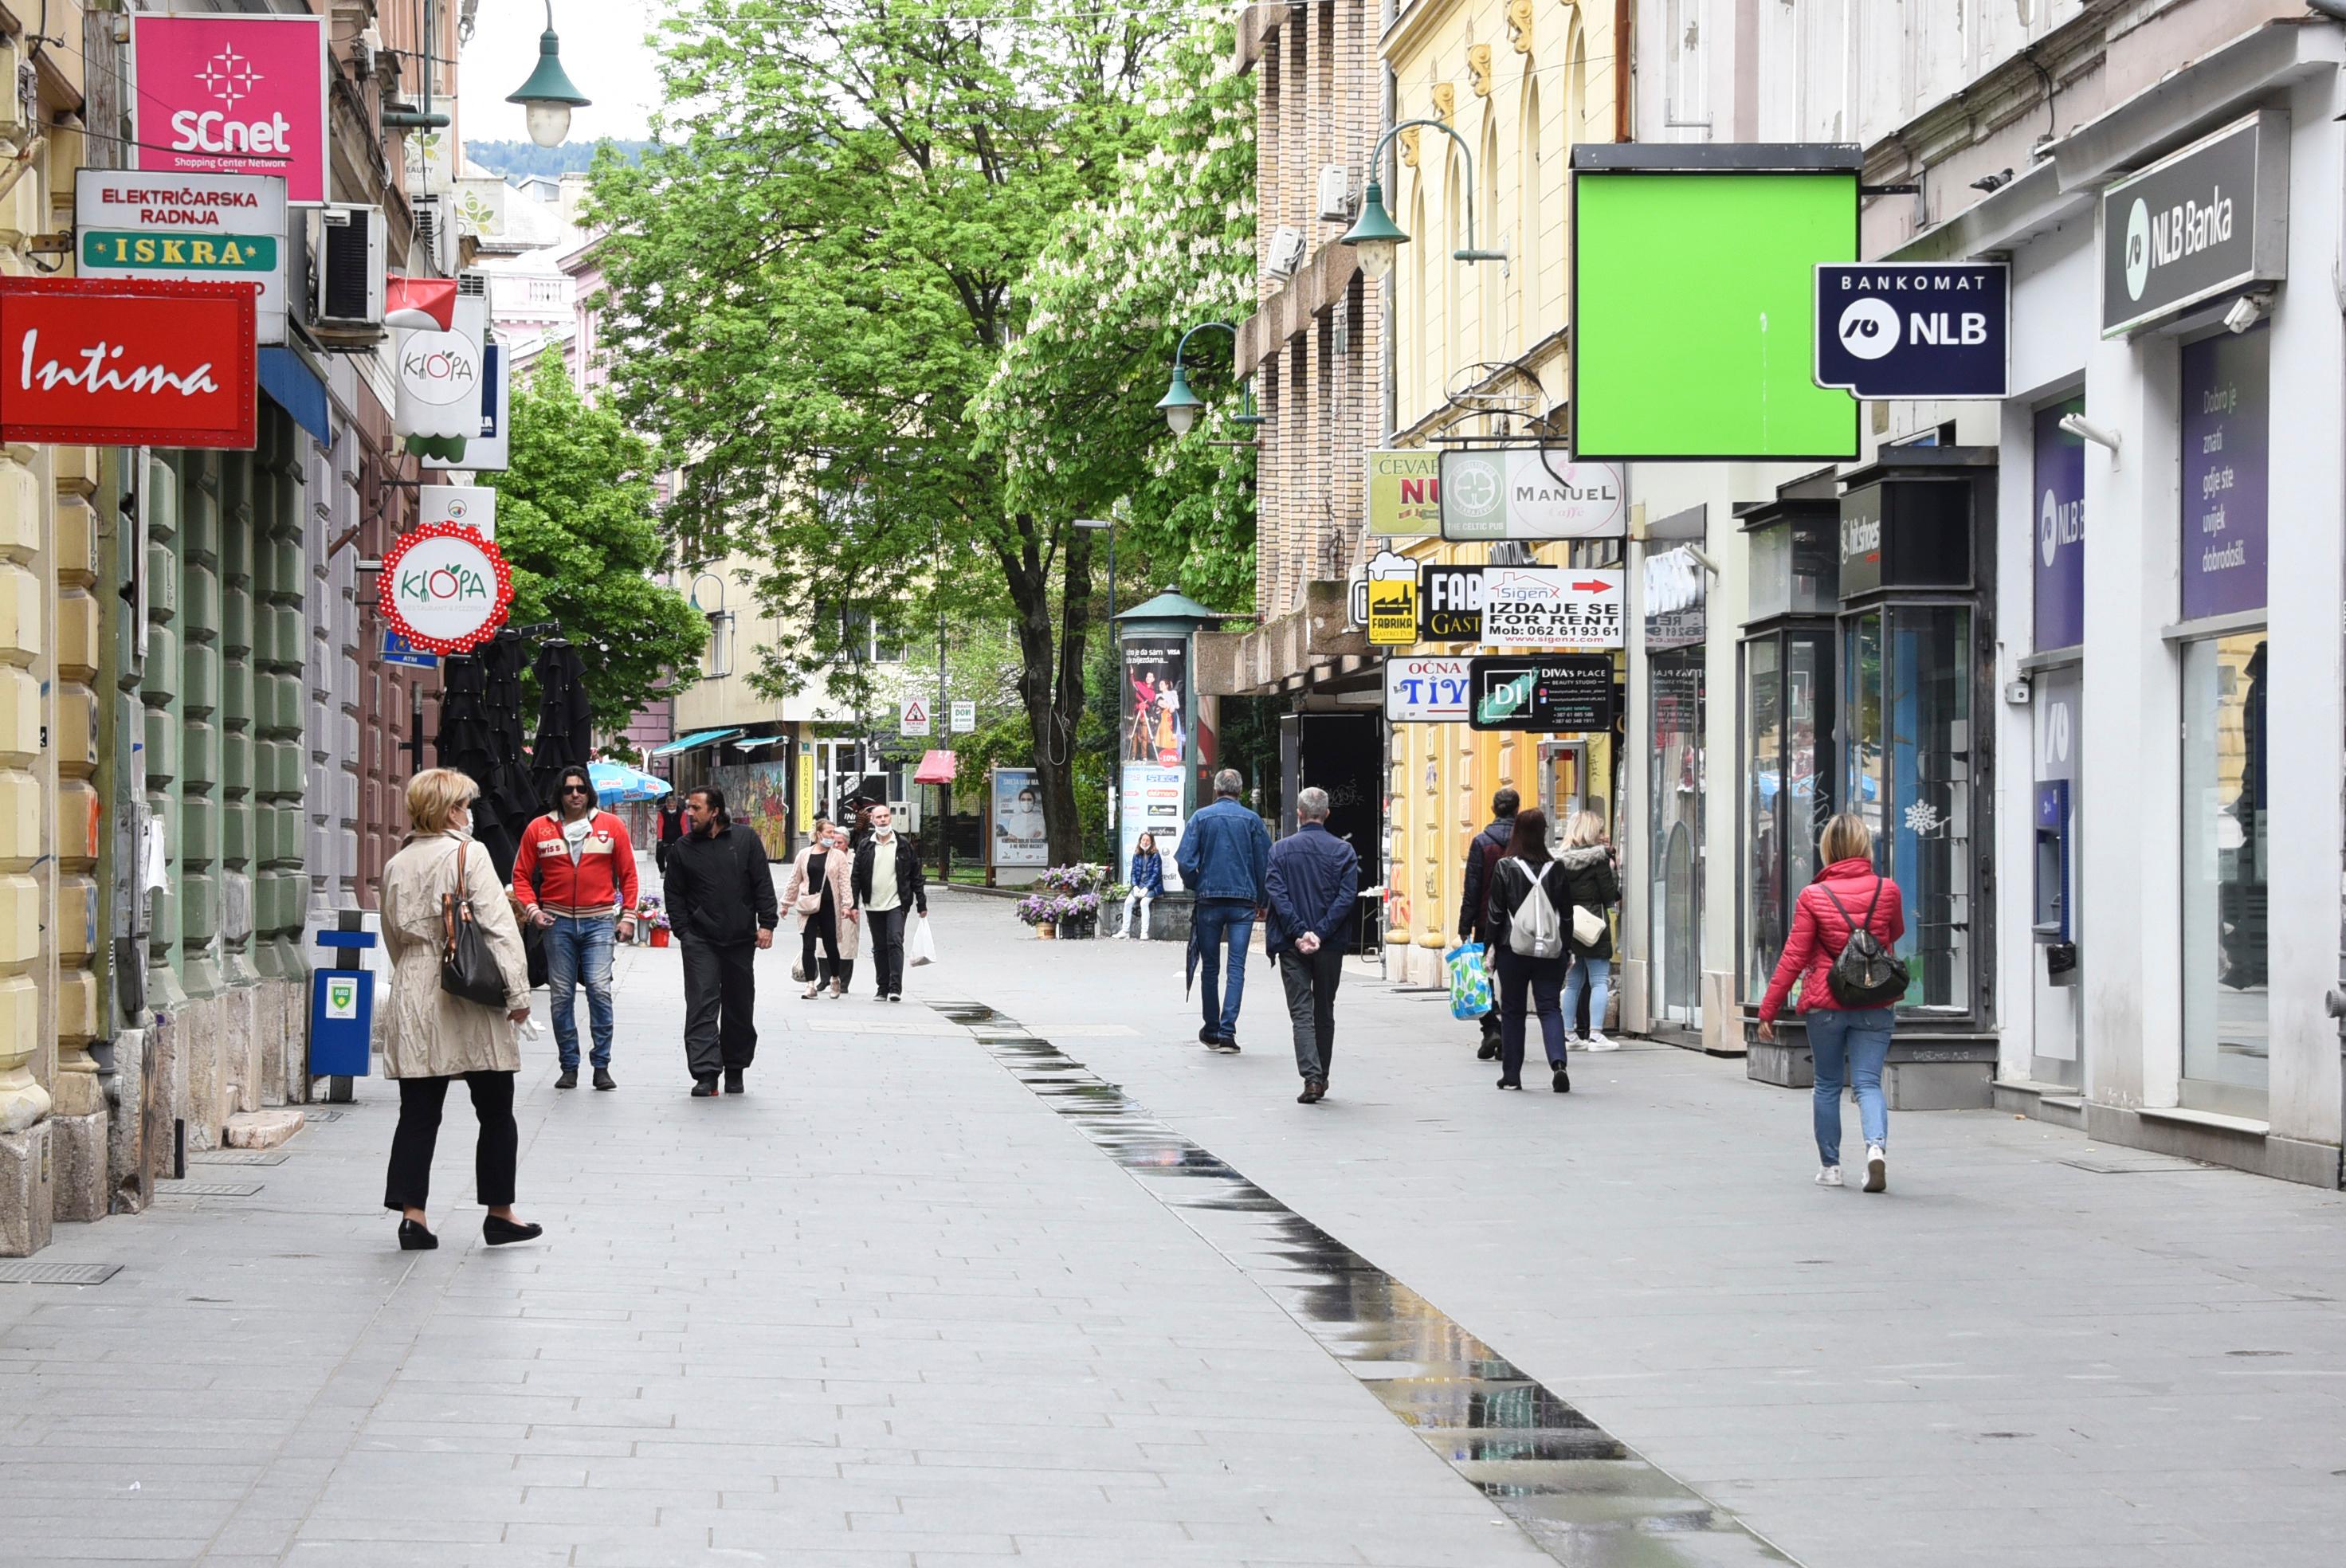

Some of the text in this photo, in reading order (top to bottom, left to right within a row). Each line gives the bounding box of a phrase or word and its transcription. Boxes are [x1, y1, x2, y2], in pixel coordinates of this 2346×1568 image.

[171, 111, 290, 152] SCnet
[175, 157, 286, 168] Shopping Center Network
[102, 187, 258, 208] ELEKTRIČARSKA
[140, 209, 219, 225] RADNJA
[2152, 185, 2232, 269] NLB Banka
[114, 238, 245, 265] ISKRA
[1842, 276, 1986, 290] BANKOMAT
[1909, 313, 1987, 345] NLB
[21, 327, 218, 397] Intima
[2203, 382, 2237, 415] Dobro je
[2203, 425, 2222, 454] znati
[1516, 485, 1616, 501] MANUEL
[2203, 466, 2234, 500] gdje ste
[2058, 500, 2078, 547] NLB
[2203, 504, 2226, 539] uvijek
[2203, 539, 2246, 573] dobrodošli.
[1431, 573, 1483, 611] FAB
[1489, 602, 1619, 614] IZDAJE SE
[1372, 617, 1412, 629] FABRIKA
[1489, 614, 1619, 625] FOR RENT
[1489, 625, 1618, 636] Mob: 062 61 93 61
[1408, 660, 1461, 674] OČNA
[1541, 668, 1575, 678] DIVA's
[1494, 684, 1523, 704] DI
[1159, 754, 1177, 762] -10%
